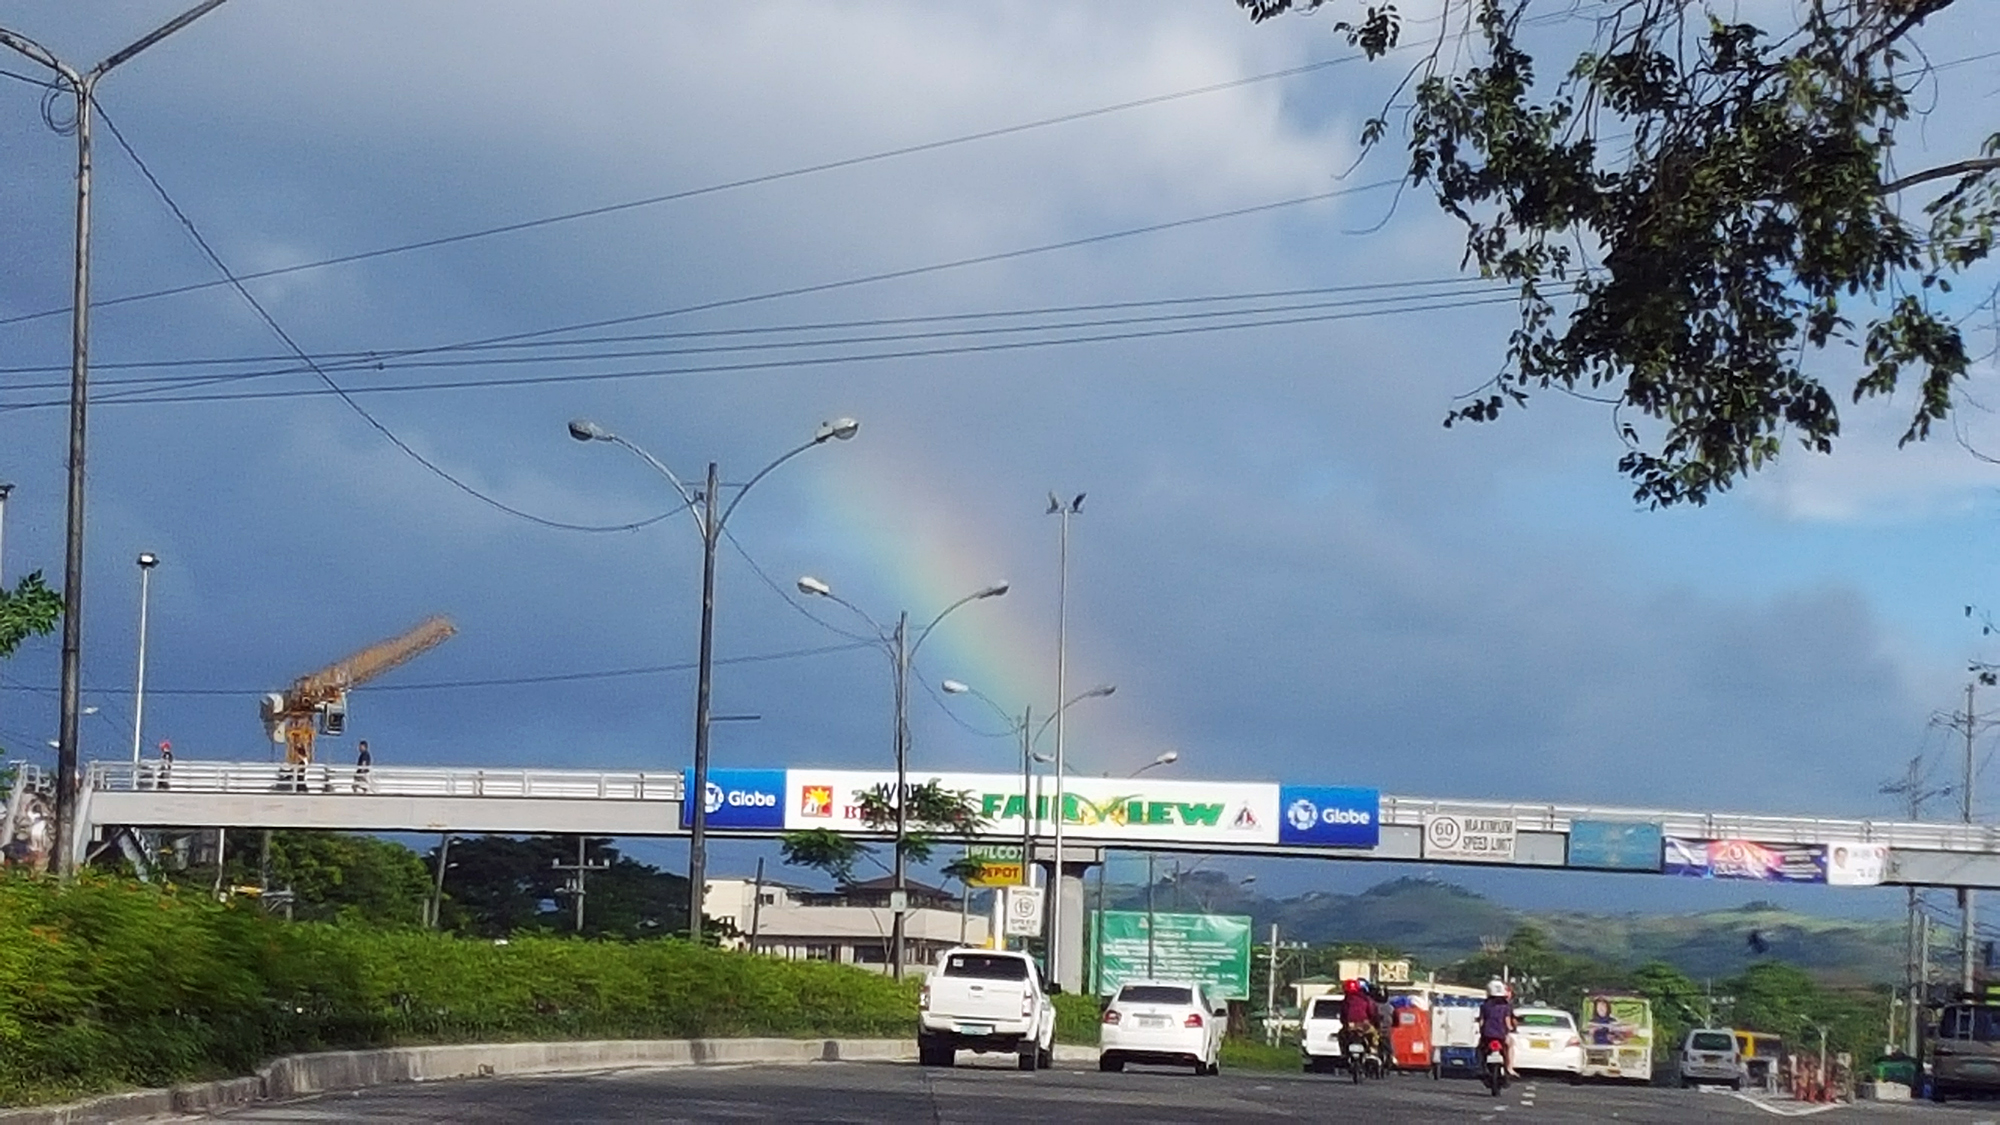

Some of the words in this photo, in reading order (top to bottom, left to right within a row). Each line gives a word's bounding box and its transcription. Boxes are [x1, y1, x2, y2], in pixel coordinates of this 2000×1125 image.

[728, 790, 776, 806] Globe
[1322, 808, 1370, 824] Globe
[1435, 822, 1454, 836] 60
